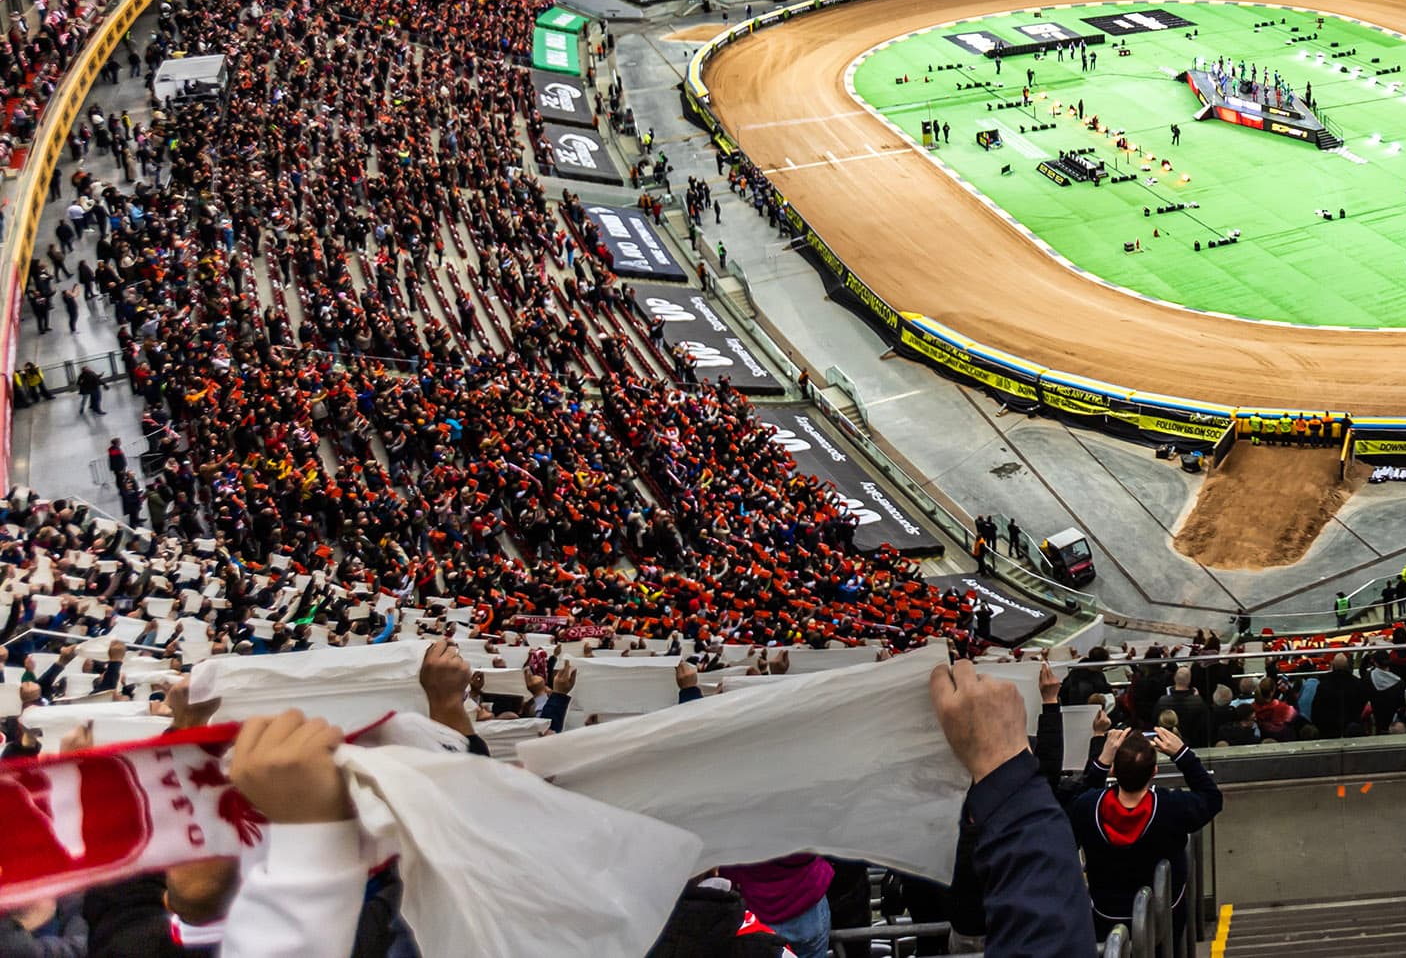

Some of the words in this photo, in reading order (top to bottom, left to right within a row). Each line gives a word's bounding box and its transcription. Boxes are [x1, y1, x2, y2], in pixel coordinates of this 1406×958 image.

[1156, 420, 1185, 433] FOLLOW
[1185, 425, 1194, 434] US
[1194, 426, 1204, 436] ON
